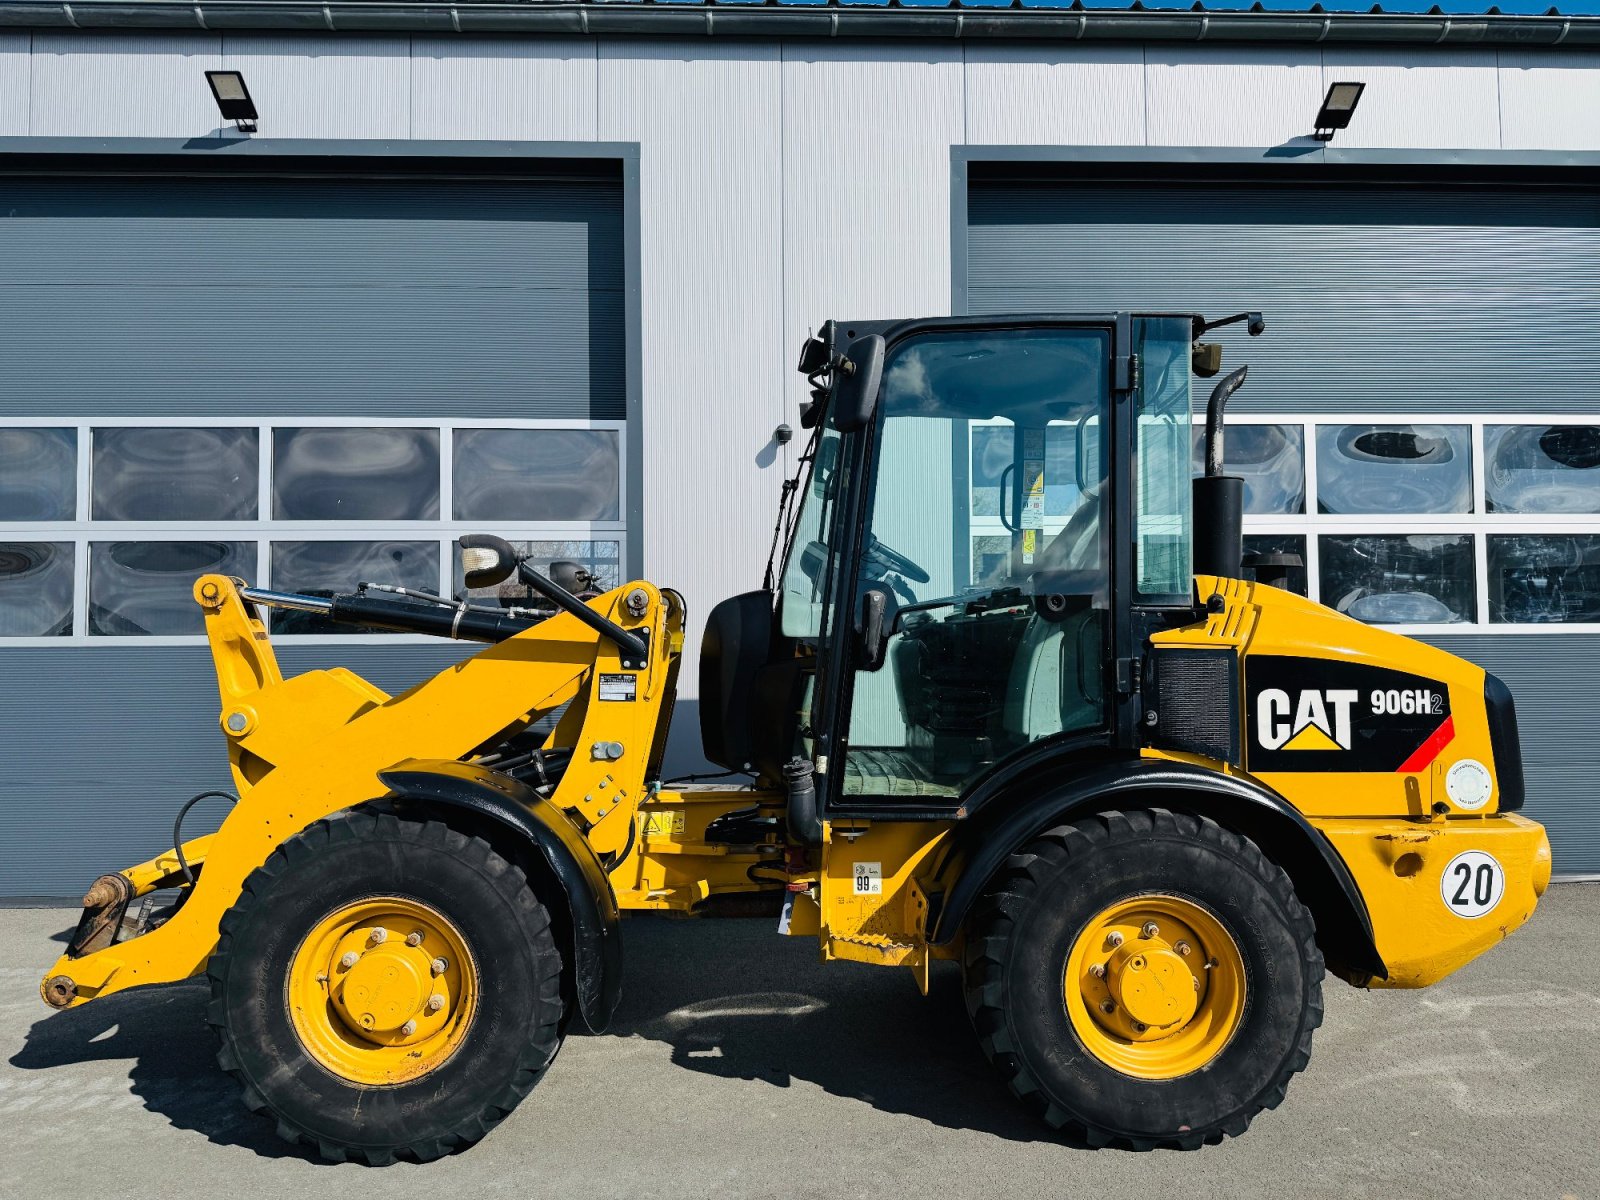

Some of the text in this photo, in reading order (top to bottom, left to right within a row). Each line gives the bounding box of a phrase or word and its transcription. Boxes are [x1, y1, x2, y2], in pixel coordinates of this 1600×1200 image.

[1257, 689, 1358, 750] CAT
[1370, 689, 1443, 715] 906H2
[857, 876, 870, 891] 99
[1452, 862, 1493, 906] 20
